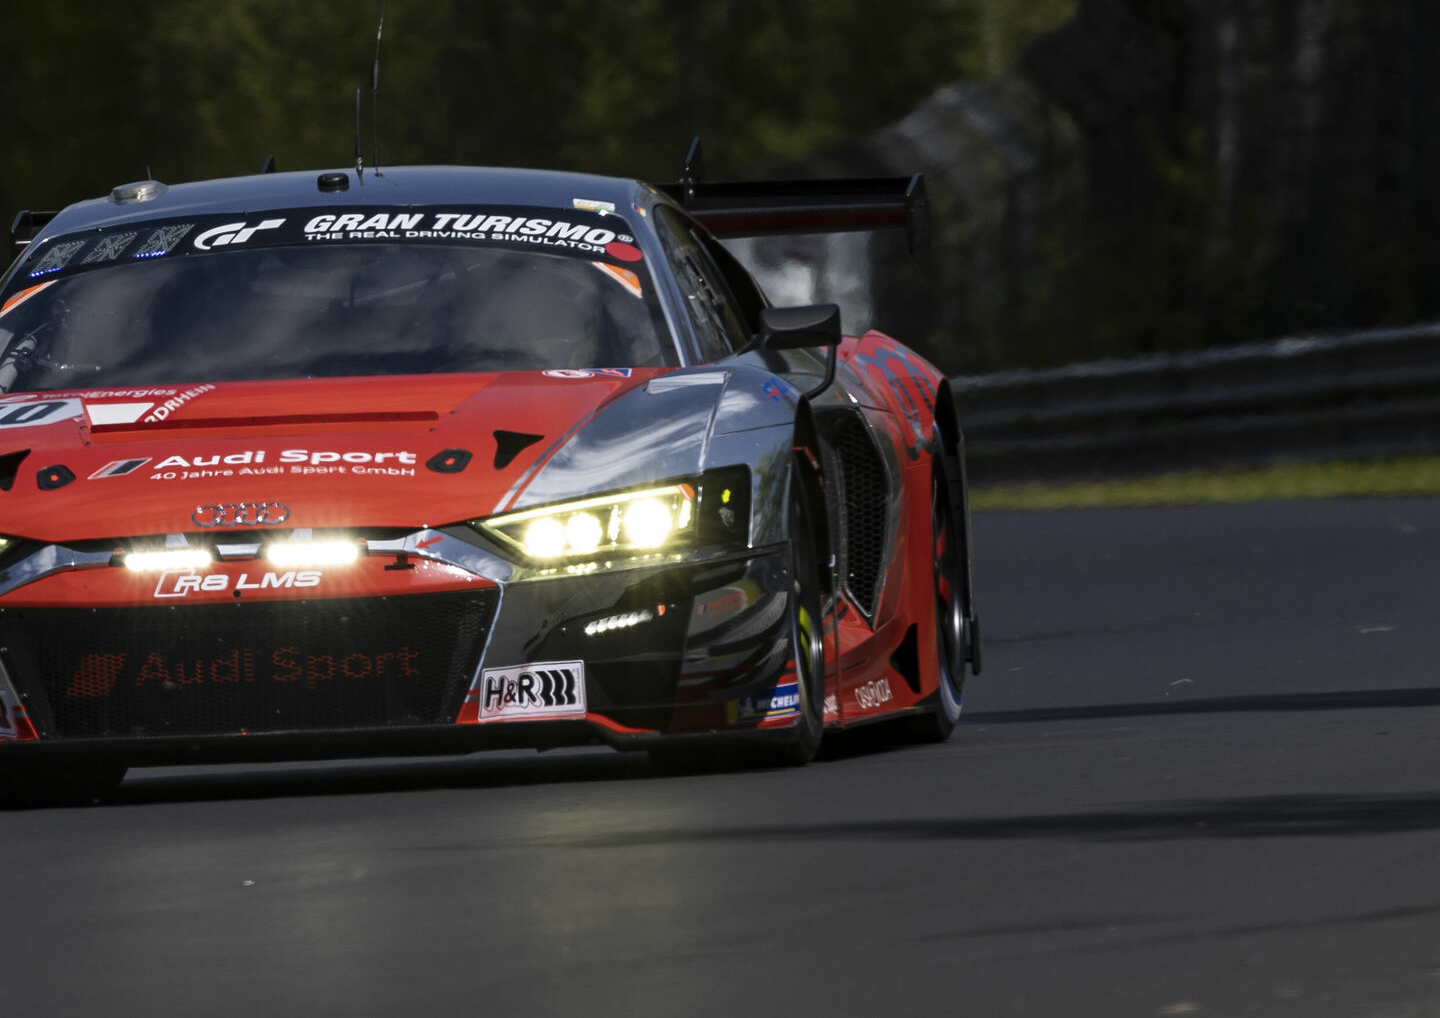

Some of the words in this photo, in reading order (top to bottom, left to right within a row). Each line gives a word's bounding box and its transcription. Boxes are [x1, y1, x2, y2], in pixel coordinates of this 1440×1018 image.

[304, 212, 425, 233] GRAN
[433, 213, 617, 246] TURISMO
[305, 233, 343, 241] THE
[405, 231, 486, 240] DRIVING
[491, 233, 606, 254] SIMULATOR
[154, 451, 265, 470] Audi
[280, 449, 417, 468] Sport
[150, 472, 176, 480] 40
[180, 469, 234, 480] Jahre
[238, 466, 285, 476] Audi
[291, 465, 346, 476] Sport
[352, 466, 416, 477] GmbH
[174, 572, 228, 592] R8
[235, 570, 322, 589] LMS
[136, 647, 254, 686] Audi
[273, 646, 420, 689] Sport
[485, 672, 539, 708] H&R
